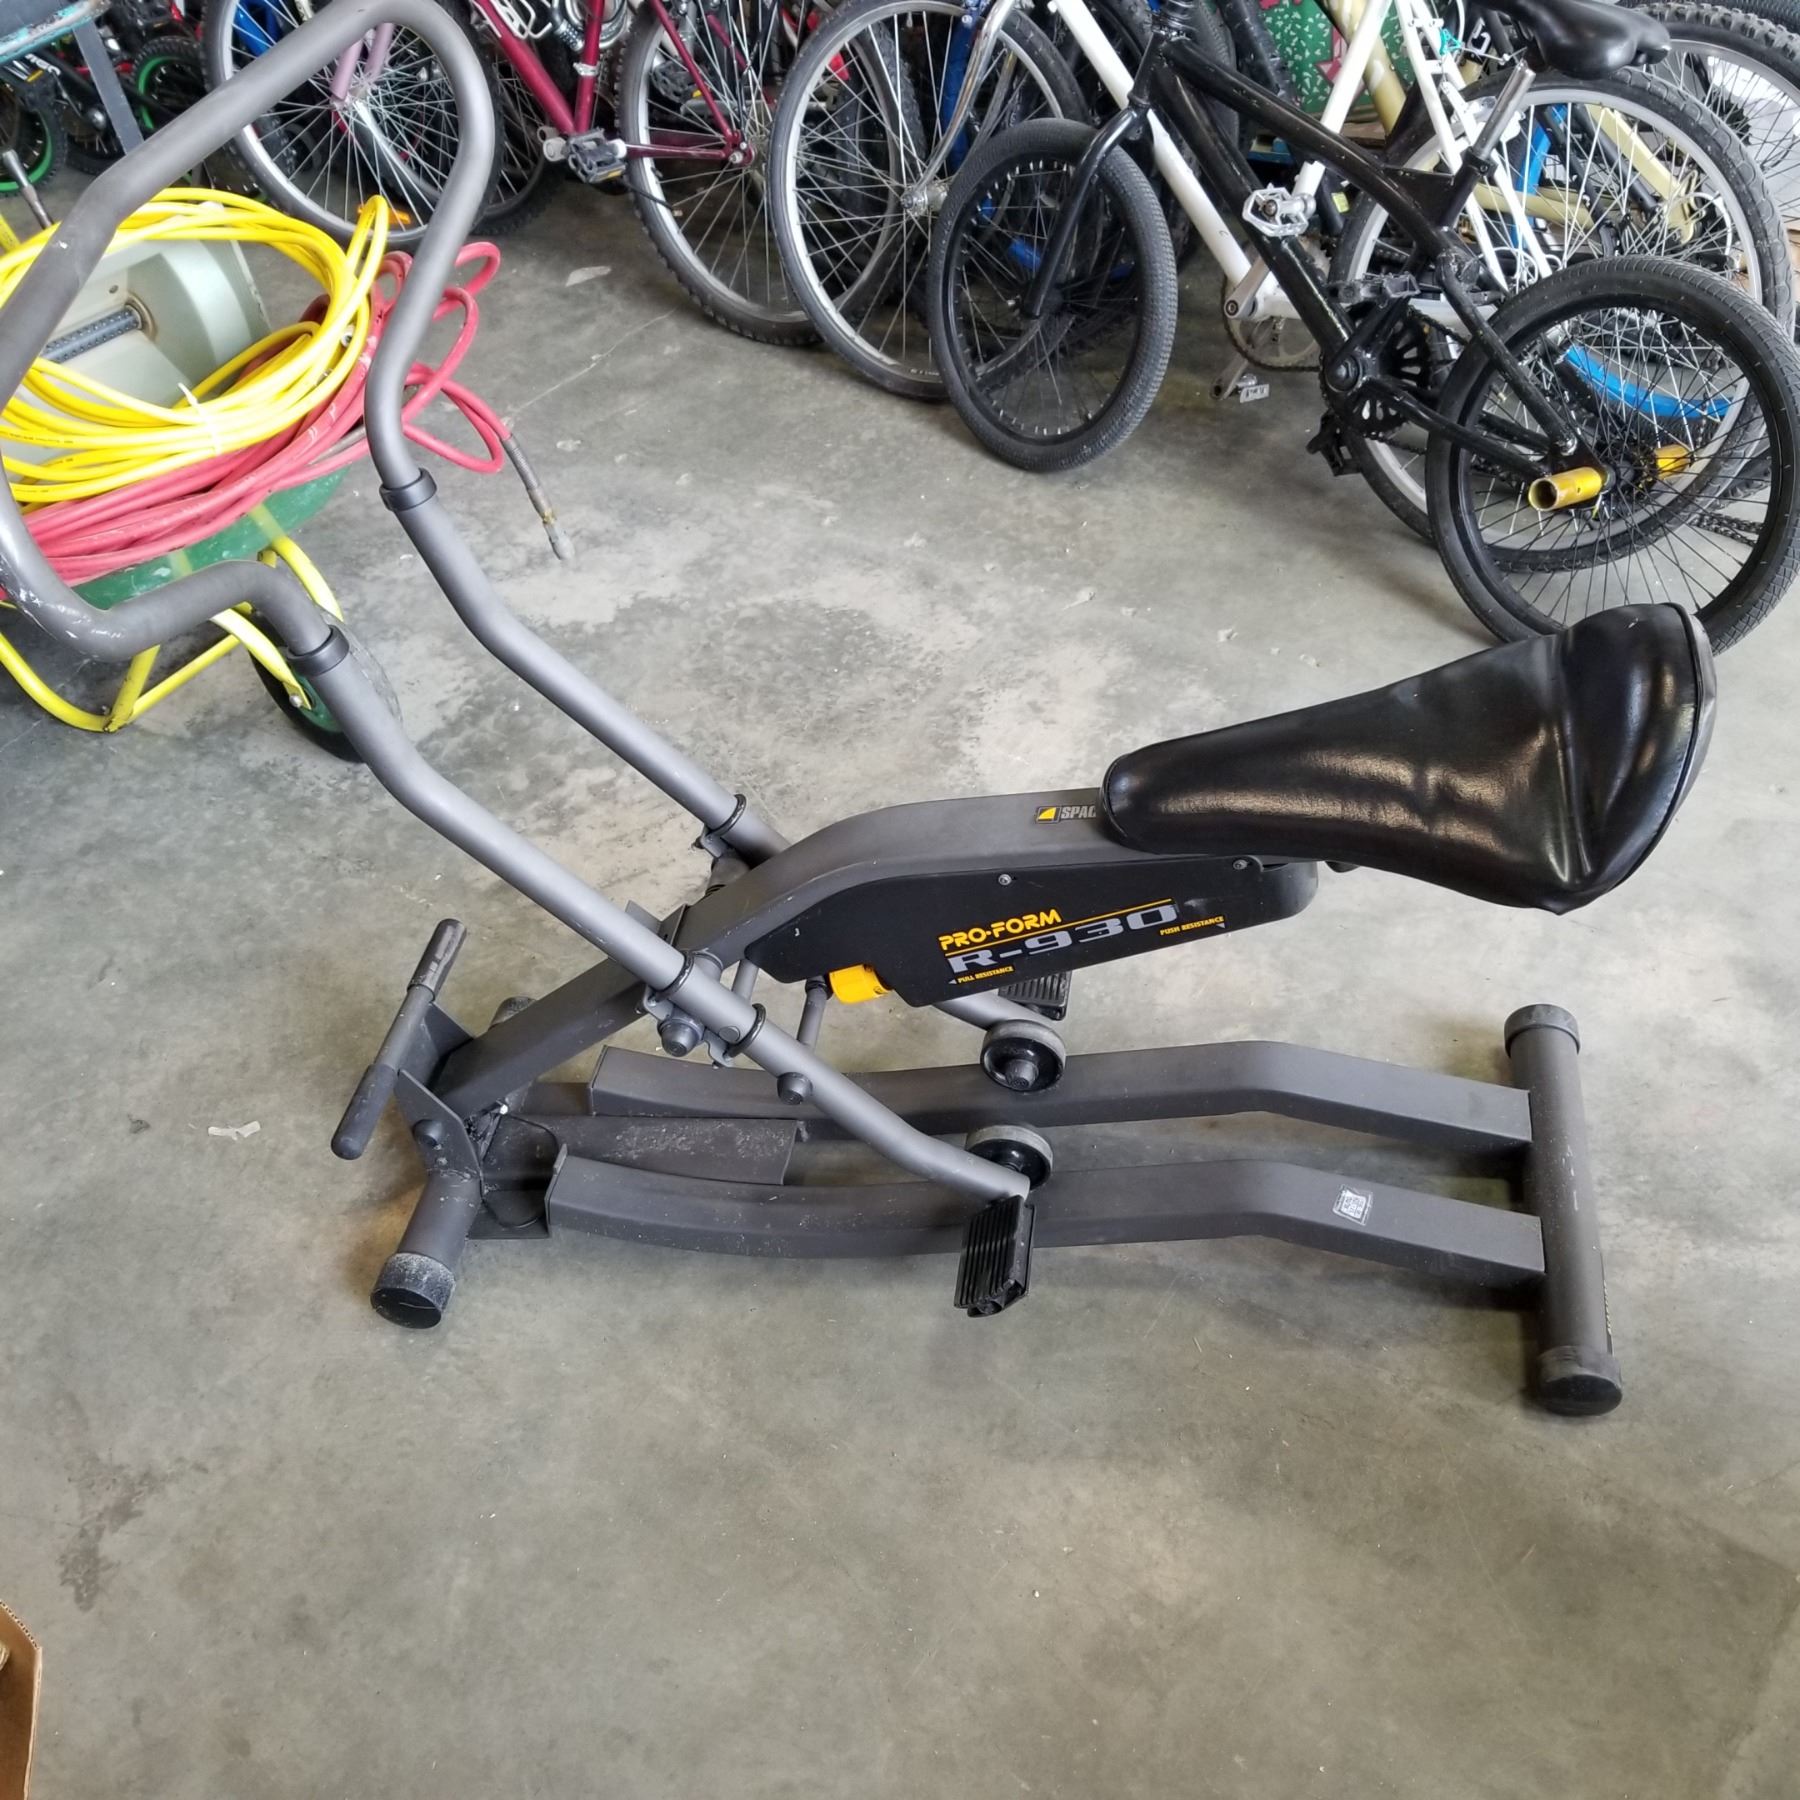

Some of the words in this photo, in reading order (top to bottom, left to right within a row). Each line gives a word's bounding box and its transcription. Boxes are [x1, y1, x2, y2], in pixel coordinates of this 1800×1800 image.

[938, 909, 1062, 951] PRO-FORM
[947, 905, 1178, 974] R-930
[1160, 926, 1181, 936] PUSH
[1181, 916, 1225, 931] RESISTANCE
[957, 975, 976, 984] PULL
[975, 966, 1014, 980] RESISTANCE
